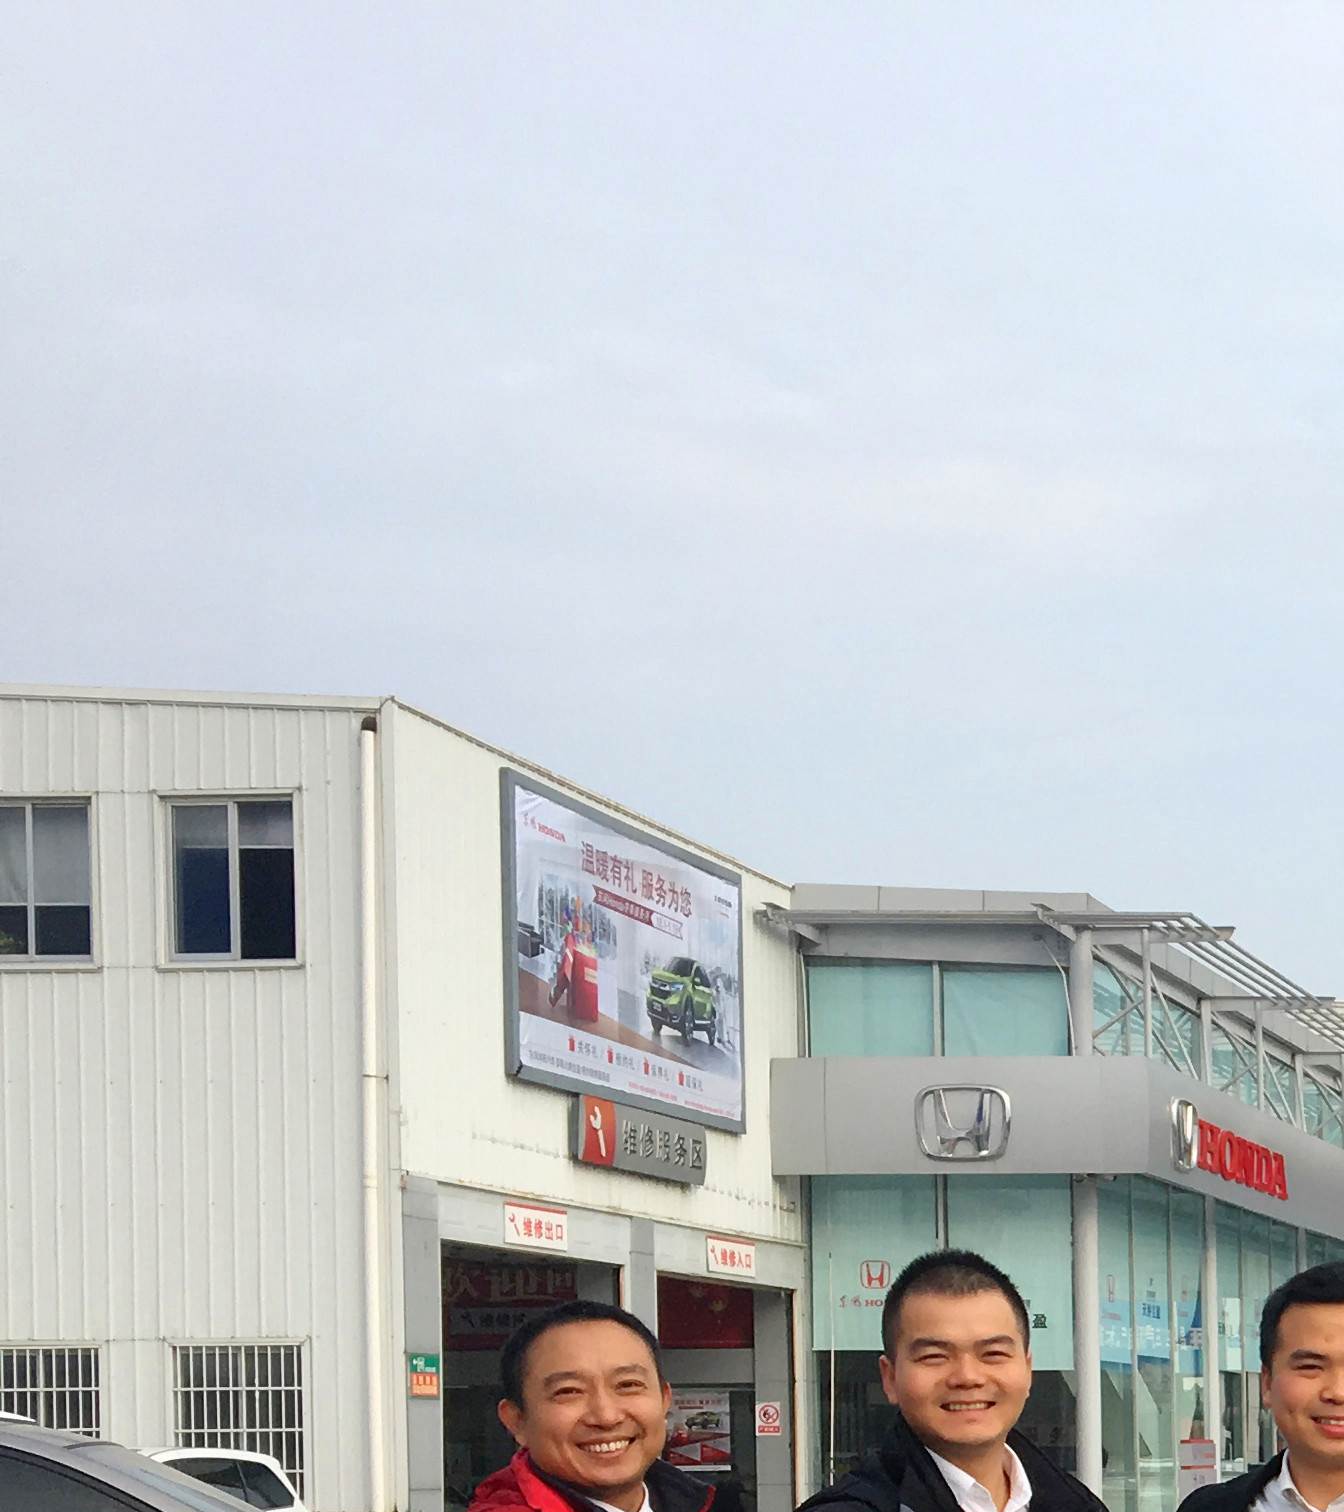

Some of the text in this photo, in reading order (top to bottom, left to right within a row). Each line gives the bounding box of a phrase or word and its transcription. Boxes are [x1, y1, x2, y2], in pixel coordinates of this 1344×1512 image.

[581, 841, 638, 894] 温暖有礼
[641, 869, 692, 918] 服务为您
[622, 1120, 704, 1169] 维修服务区
[1197, 1118, 1289, 1201] HONDA
[522, 1216, 564, 1241] 维修出口
[720, 1246, 752, 1269] 维修入口
